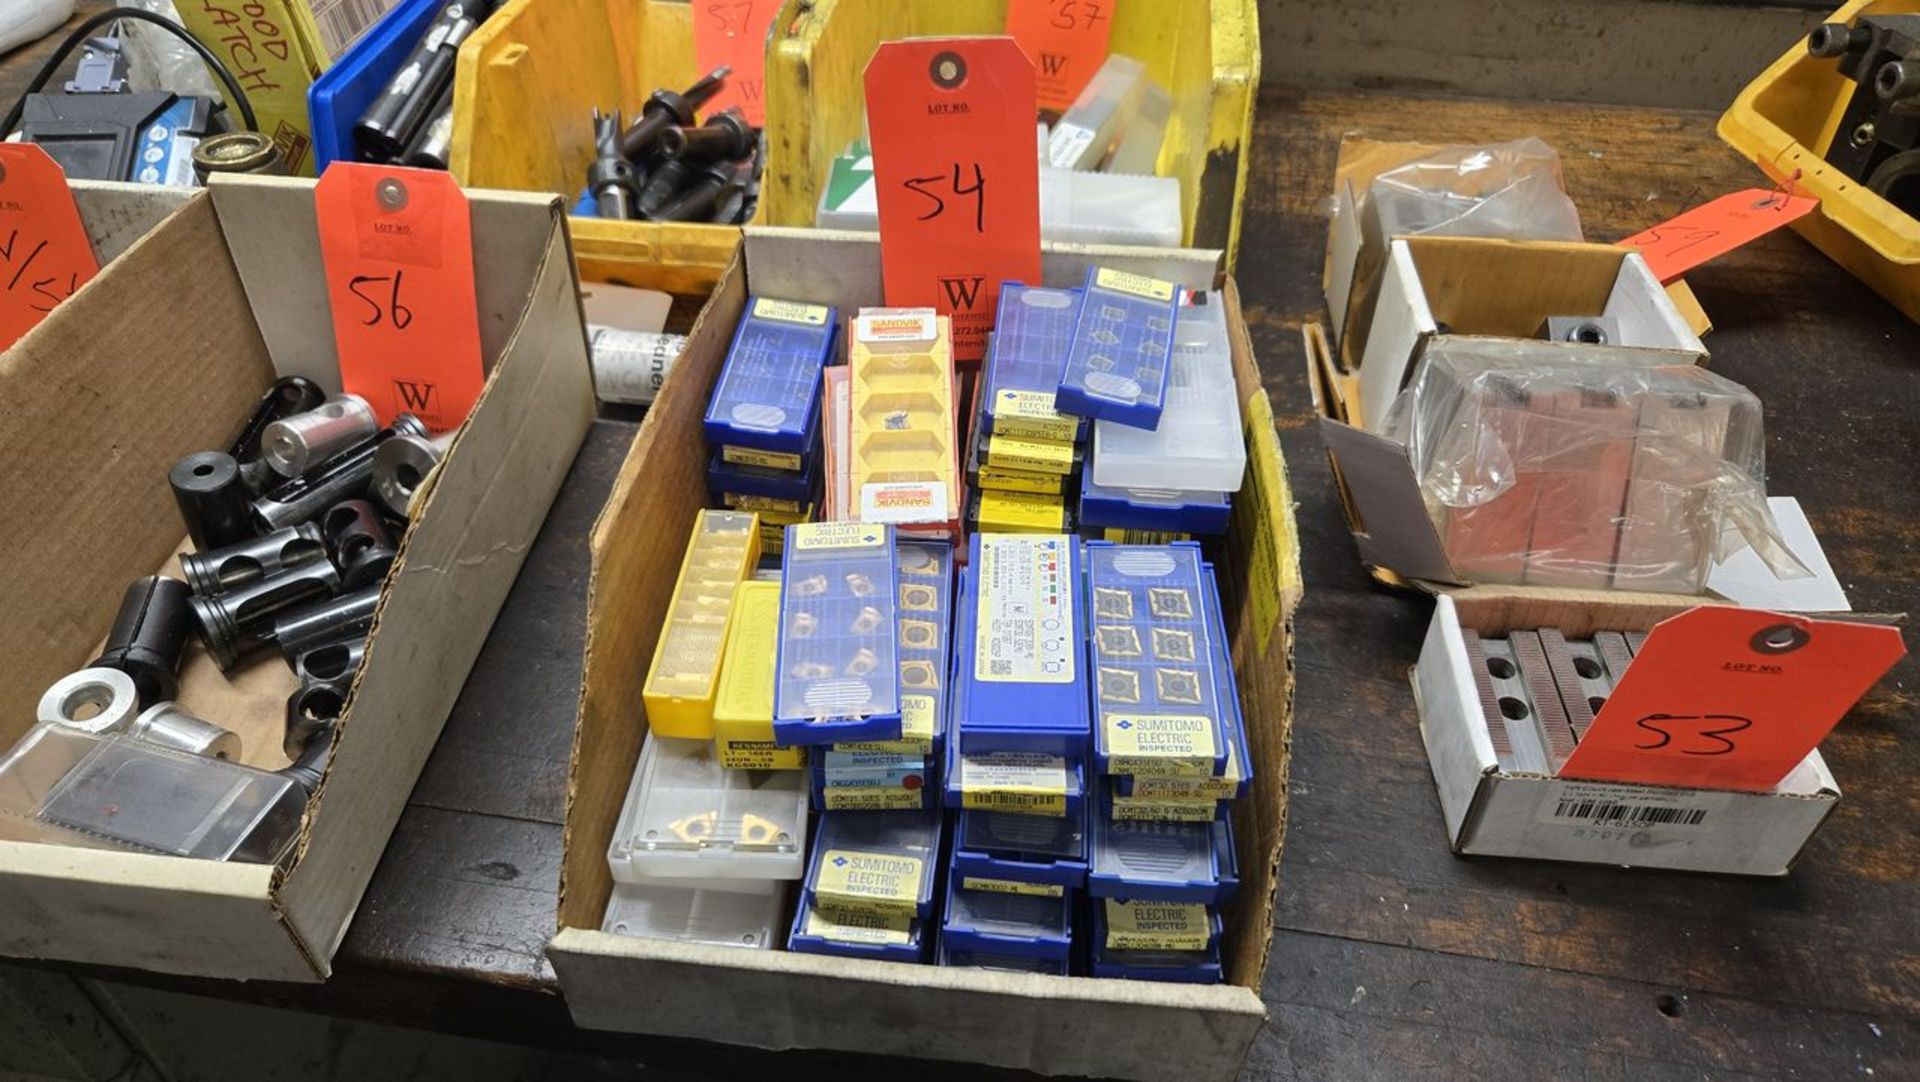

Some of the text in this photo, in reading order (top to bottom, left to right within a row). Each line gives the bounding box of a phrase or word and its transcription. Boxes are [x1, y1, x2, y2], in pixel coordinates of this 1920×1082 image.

[1051, 2, 1107, 30] 57
[1041, 53, 1068, 76] W
[927, 104, 949, 114] LOT
[902, 162, 986, 234] 54
[374, 223, 391, 233] LOT
[348, 270, 413, 330] 56
[940, 277, 985, 311] W
[870, 318, 922, 329] SANDVIK
[395, 380, 434, 412] W
[876, 498, 932, 508] SANDVIK
[816, 527, 861, 536] ELECTRIC
[804, 536, 861, 546] SUMITOMO
[1721, 662, 1756, 672] LOT
[1136, 719, 1204, 732] SUMITOMO
[1137, 732, 1192, 744] ELECTRIC
[1633, 712, 1753, 757] 53
[1138, 744, 1193, 752] INSPECTED
[851, 856, 914, 875] SUMITOMO
[848, 871, 900, 888] ELECTRIC
[846, 884, 898, 896] INSPECTED
[837, 913, 889, 929] ELECTRIC
[1134, 908, 1187, 921] ELECTRIC
[1136, 922, 1188, 930] INSPECTED
